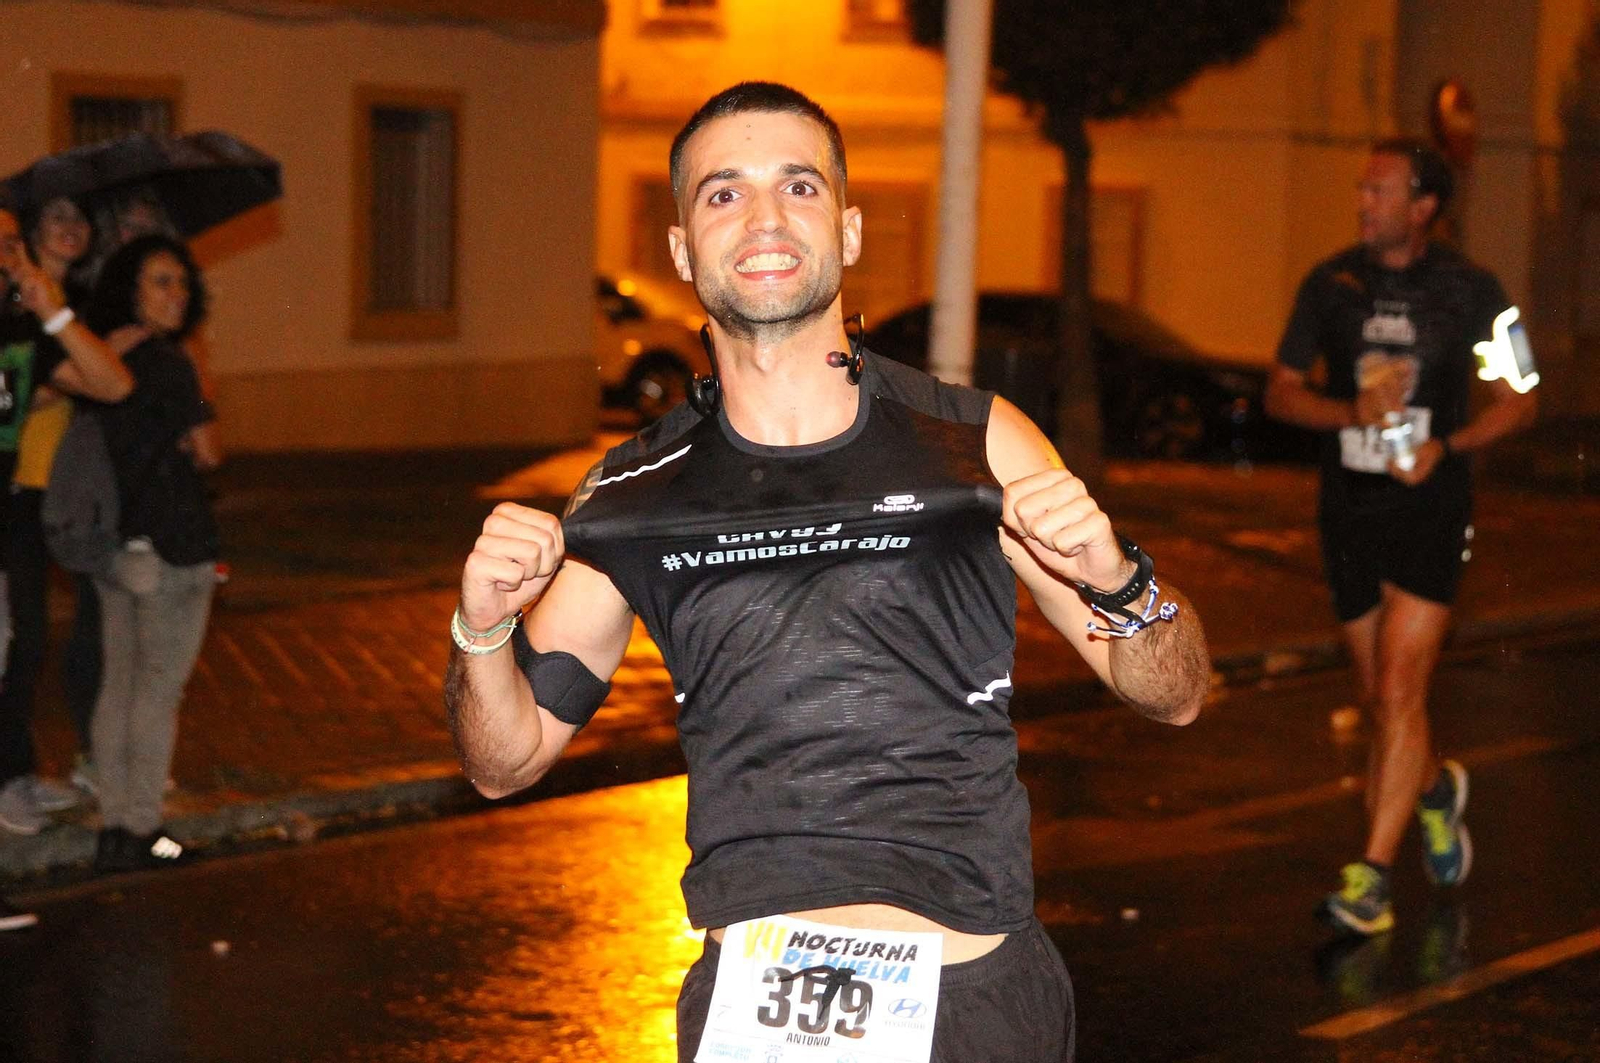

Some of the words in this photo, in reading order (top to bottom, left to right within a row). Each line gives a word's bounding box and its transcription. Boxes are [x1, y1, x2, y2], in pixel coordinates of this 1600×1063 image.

[788, 930, 918, 962] NOCTURNA
[782, 948, 813, 969] DE
[822, 956, 912, 985] HUELVA
[757, 966, 874, 1039] 359
[786, 1032, 831, 1047] ANTONIO
